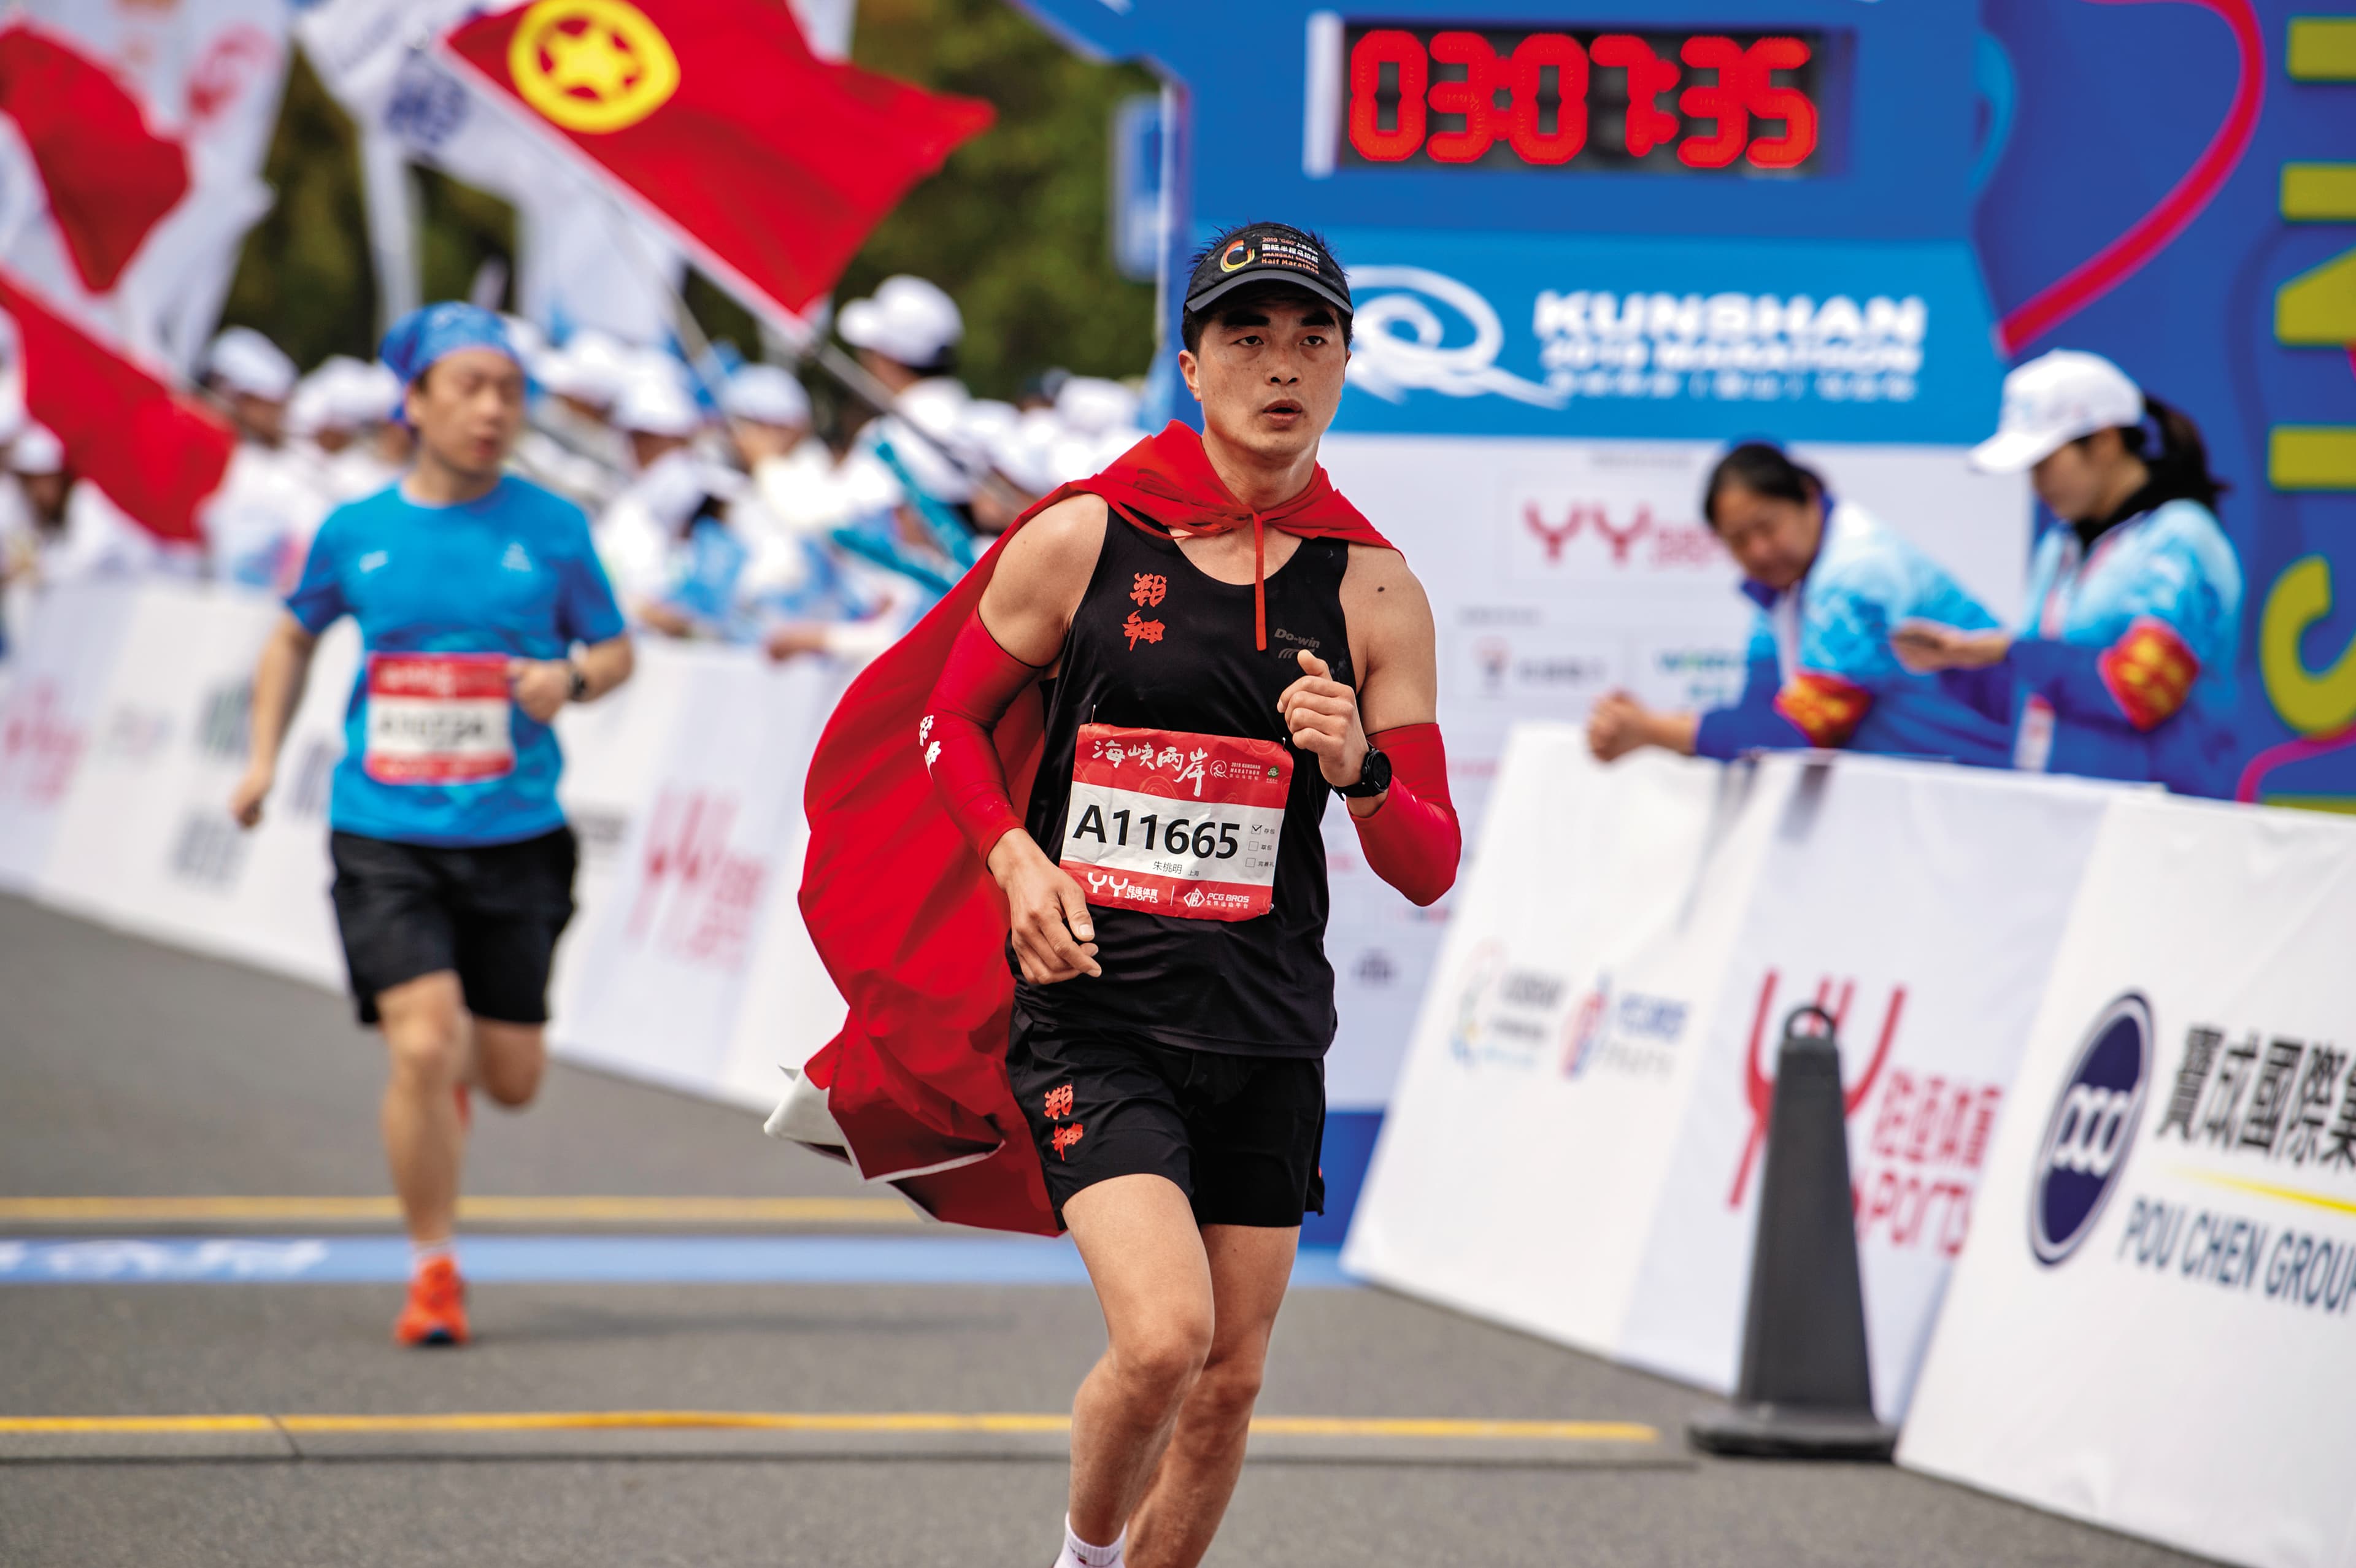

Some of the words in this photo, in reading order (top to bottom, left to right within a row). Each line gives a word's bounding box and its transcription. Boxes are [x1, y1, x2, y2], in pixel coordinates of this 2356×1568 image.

[1349, 29, 1817, 168] 03:07:35
[1282, 259, 1320, 275] Marathon
[1533, 290, 1928, 344] KUNSHAN
[1274, 628, 1320, 648] Do-win
[1072, 804, 1241, 859] A11665
[1152, 861, 1183, 874] 朱桃明
[1088, 872, 1129, 897] YY
[1225, 894, 1250, 903] BROS
[2117, 1195, 2185, 1269] POU
[2181, 1211, 2269, 1288] CHEN
